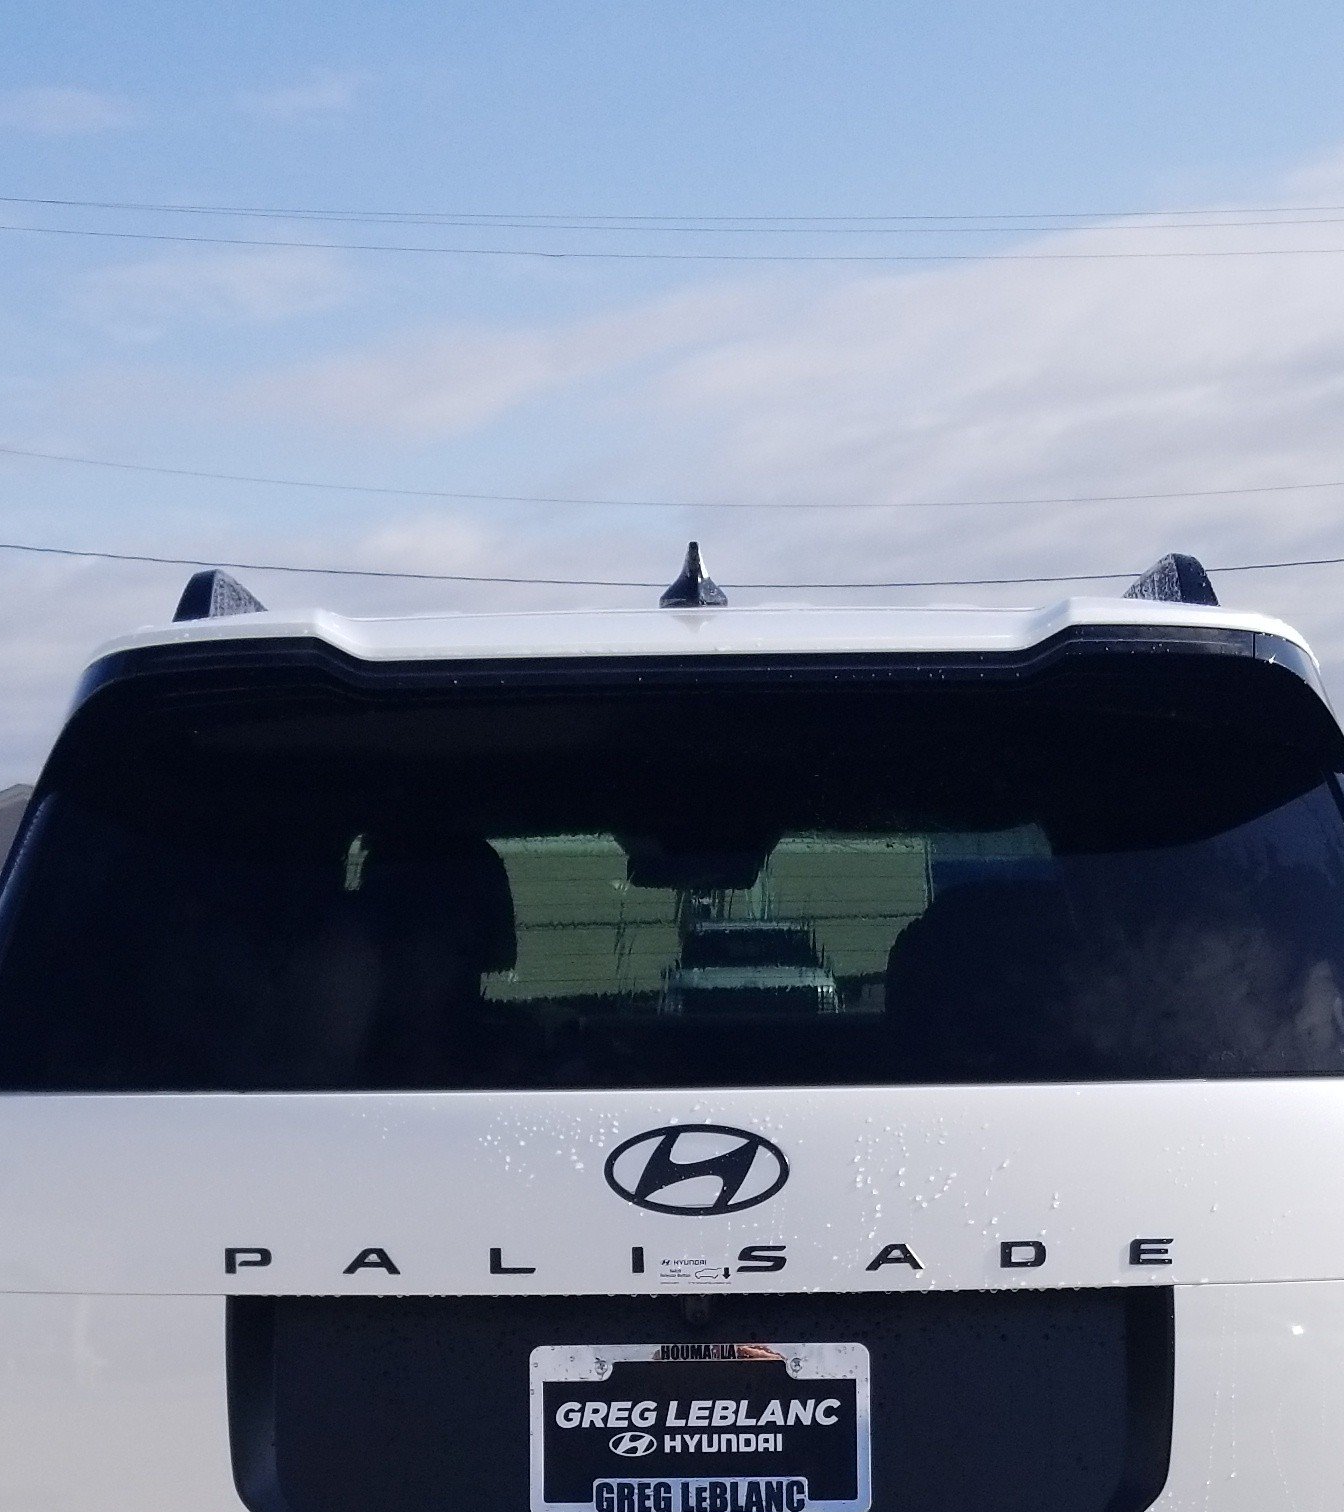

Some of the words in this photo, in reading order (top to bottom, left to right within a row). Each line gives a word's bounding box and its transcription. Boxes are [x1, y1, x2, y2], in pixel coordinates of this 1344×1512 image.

[223, 1236, 1176, 1276] PALISADE
[660, 1344, 711, 1360] HOUMA
[556, 1400, 657, 1429] GREG
[665, 1398, 841, 1427] LEBLANC
[664, 1433, 783, 1453] HYUNDAI
